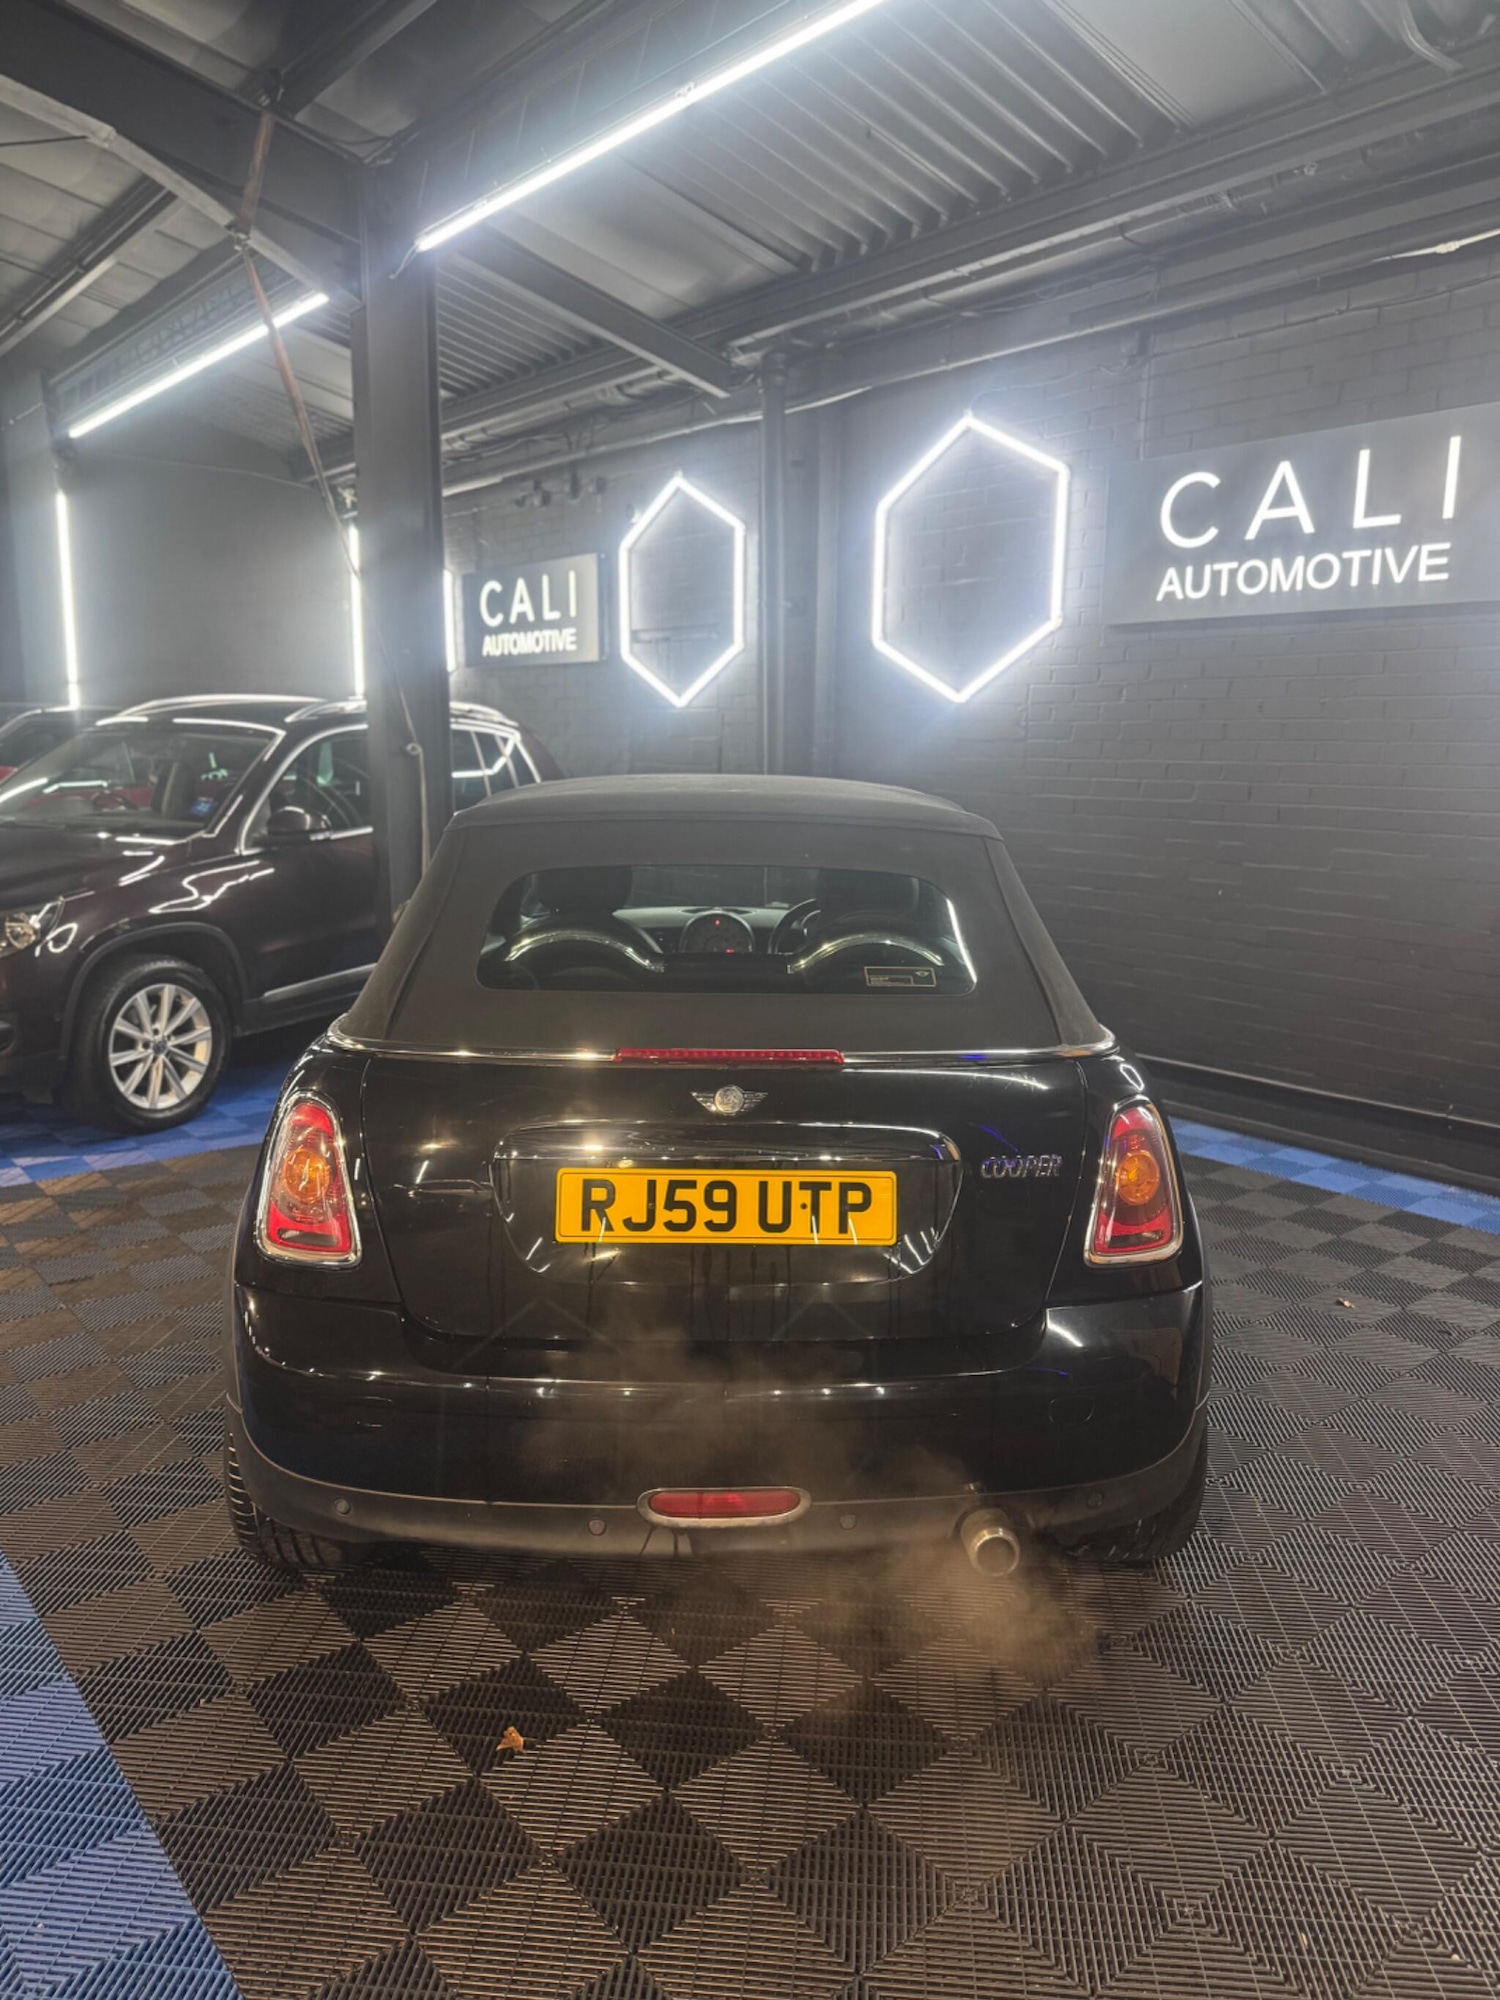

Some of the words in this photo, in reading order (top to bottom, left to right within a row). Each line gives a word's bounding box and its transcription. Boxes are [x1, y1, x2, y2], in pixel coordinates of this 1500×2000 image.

[1159, 435, 1462, 549] CALI
[479, 569, 577, 627] CALI
[1155, 542, 1452, 602] AUTOMOTIVE
[482, 627, 577, 657] AUTOMOTIVE
[981, 1154, 1063, 1179] COOPER
[580, 1178, 738, 1234] RJ59
[757, 1180, 872, 1235] UTP
